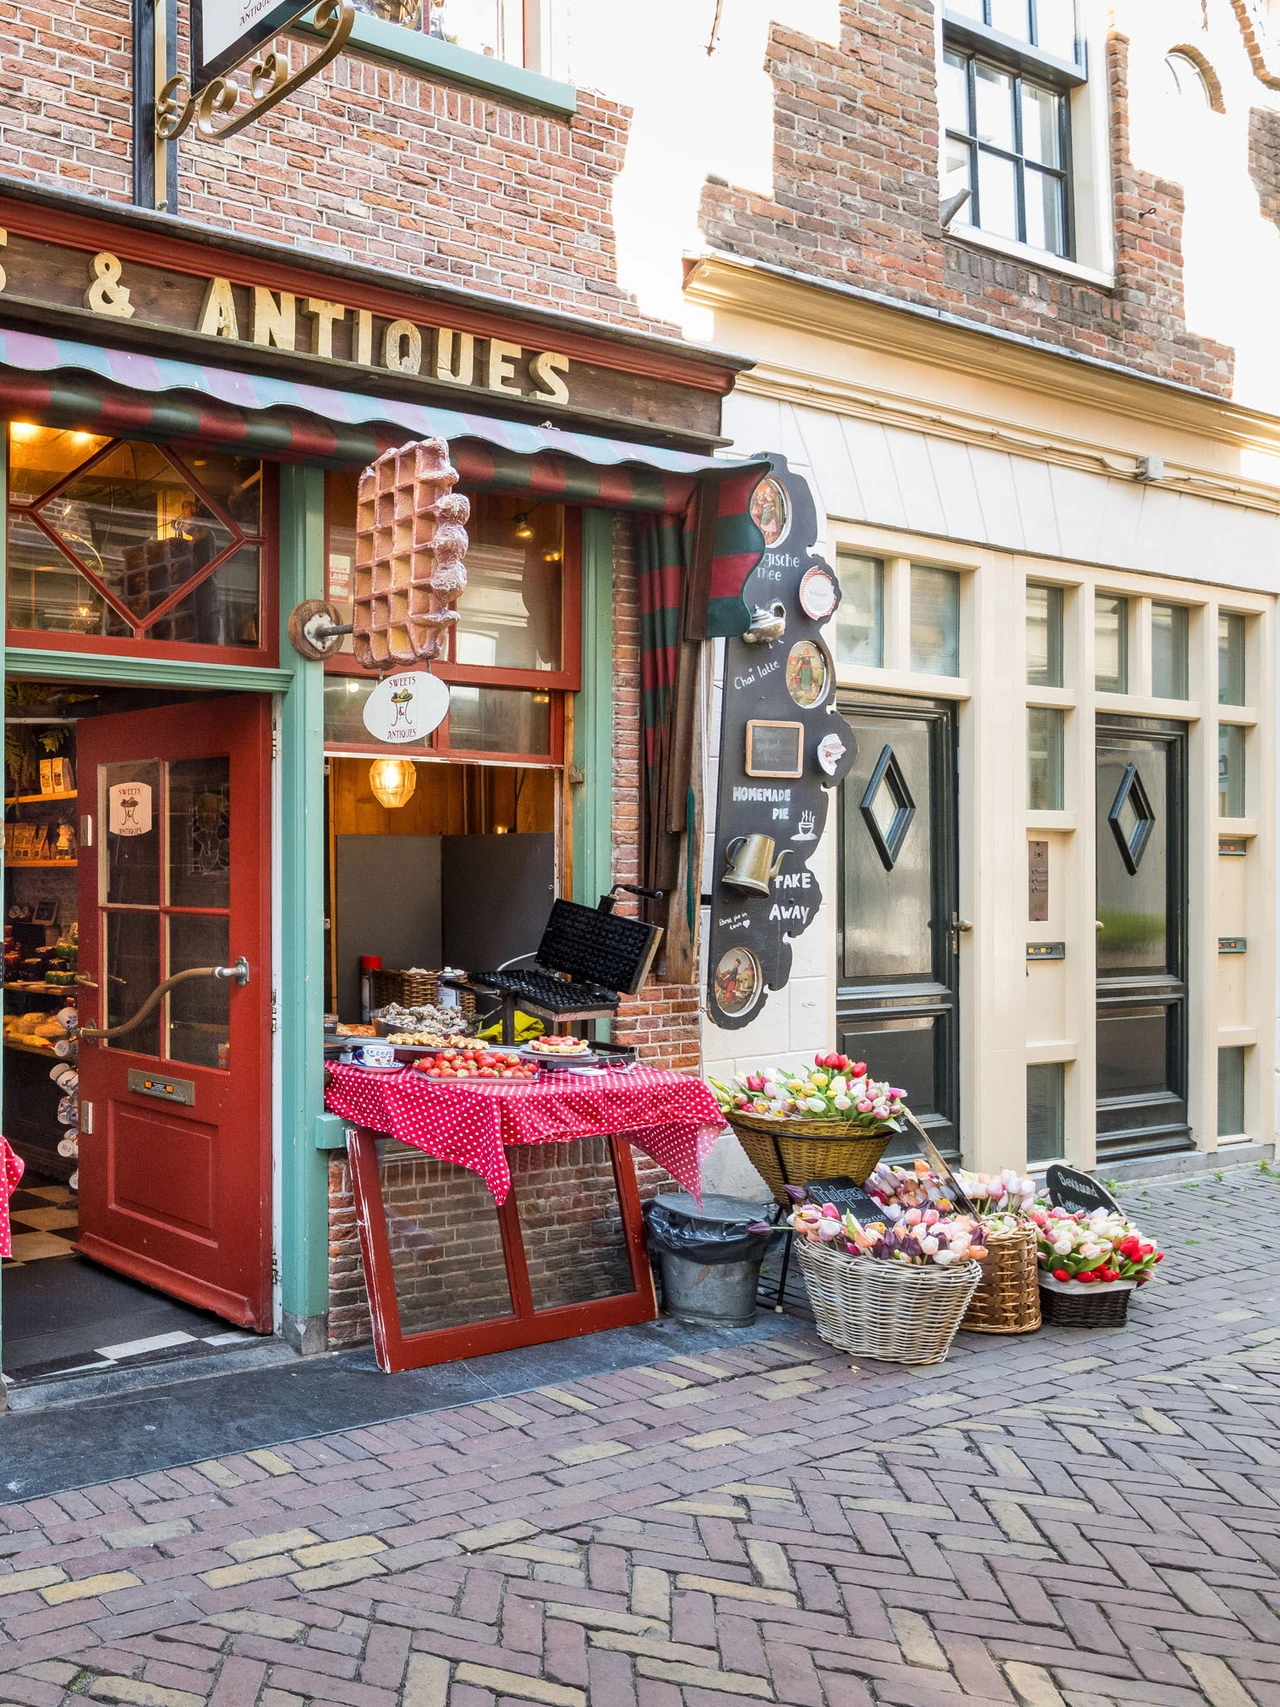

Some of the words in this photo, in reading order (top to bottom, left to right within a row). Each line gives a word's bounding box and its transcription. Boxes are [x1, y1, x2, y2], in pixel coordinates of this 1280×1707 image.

[83, 251, 135, 318] &
[197, 277, 570, 405] ANTIQUES
[764, 553, 800, 568] gische
[388, 676, 416, 688] SWEETS
[734, 668, 755, 690] Chai
[758, 660, 780, 679] latte
[386, 729, 417, 740] ANTIQUES
[118, 788, 141, 796] SWEETS
[732, 787, 791, 802] HOMEMADE
[772, 807, 789, 820] PIE
[774, 873, 811, 888] TAKE
[810, 1185, 869, 1209] Tulpen
